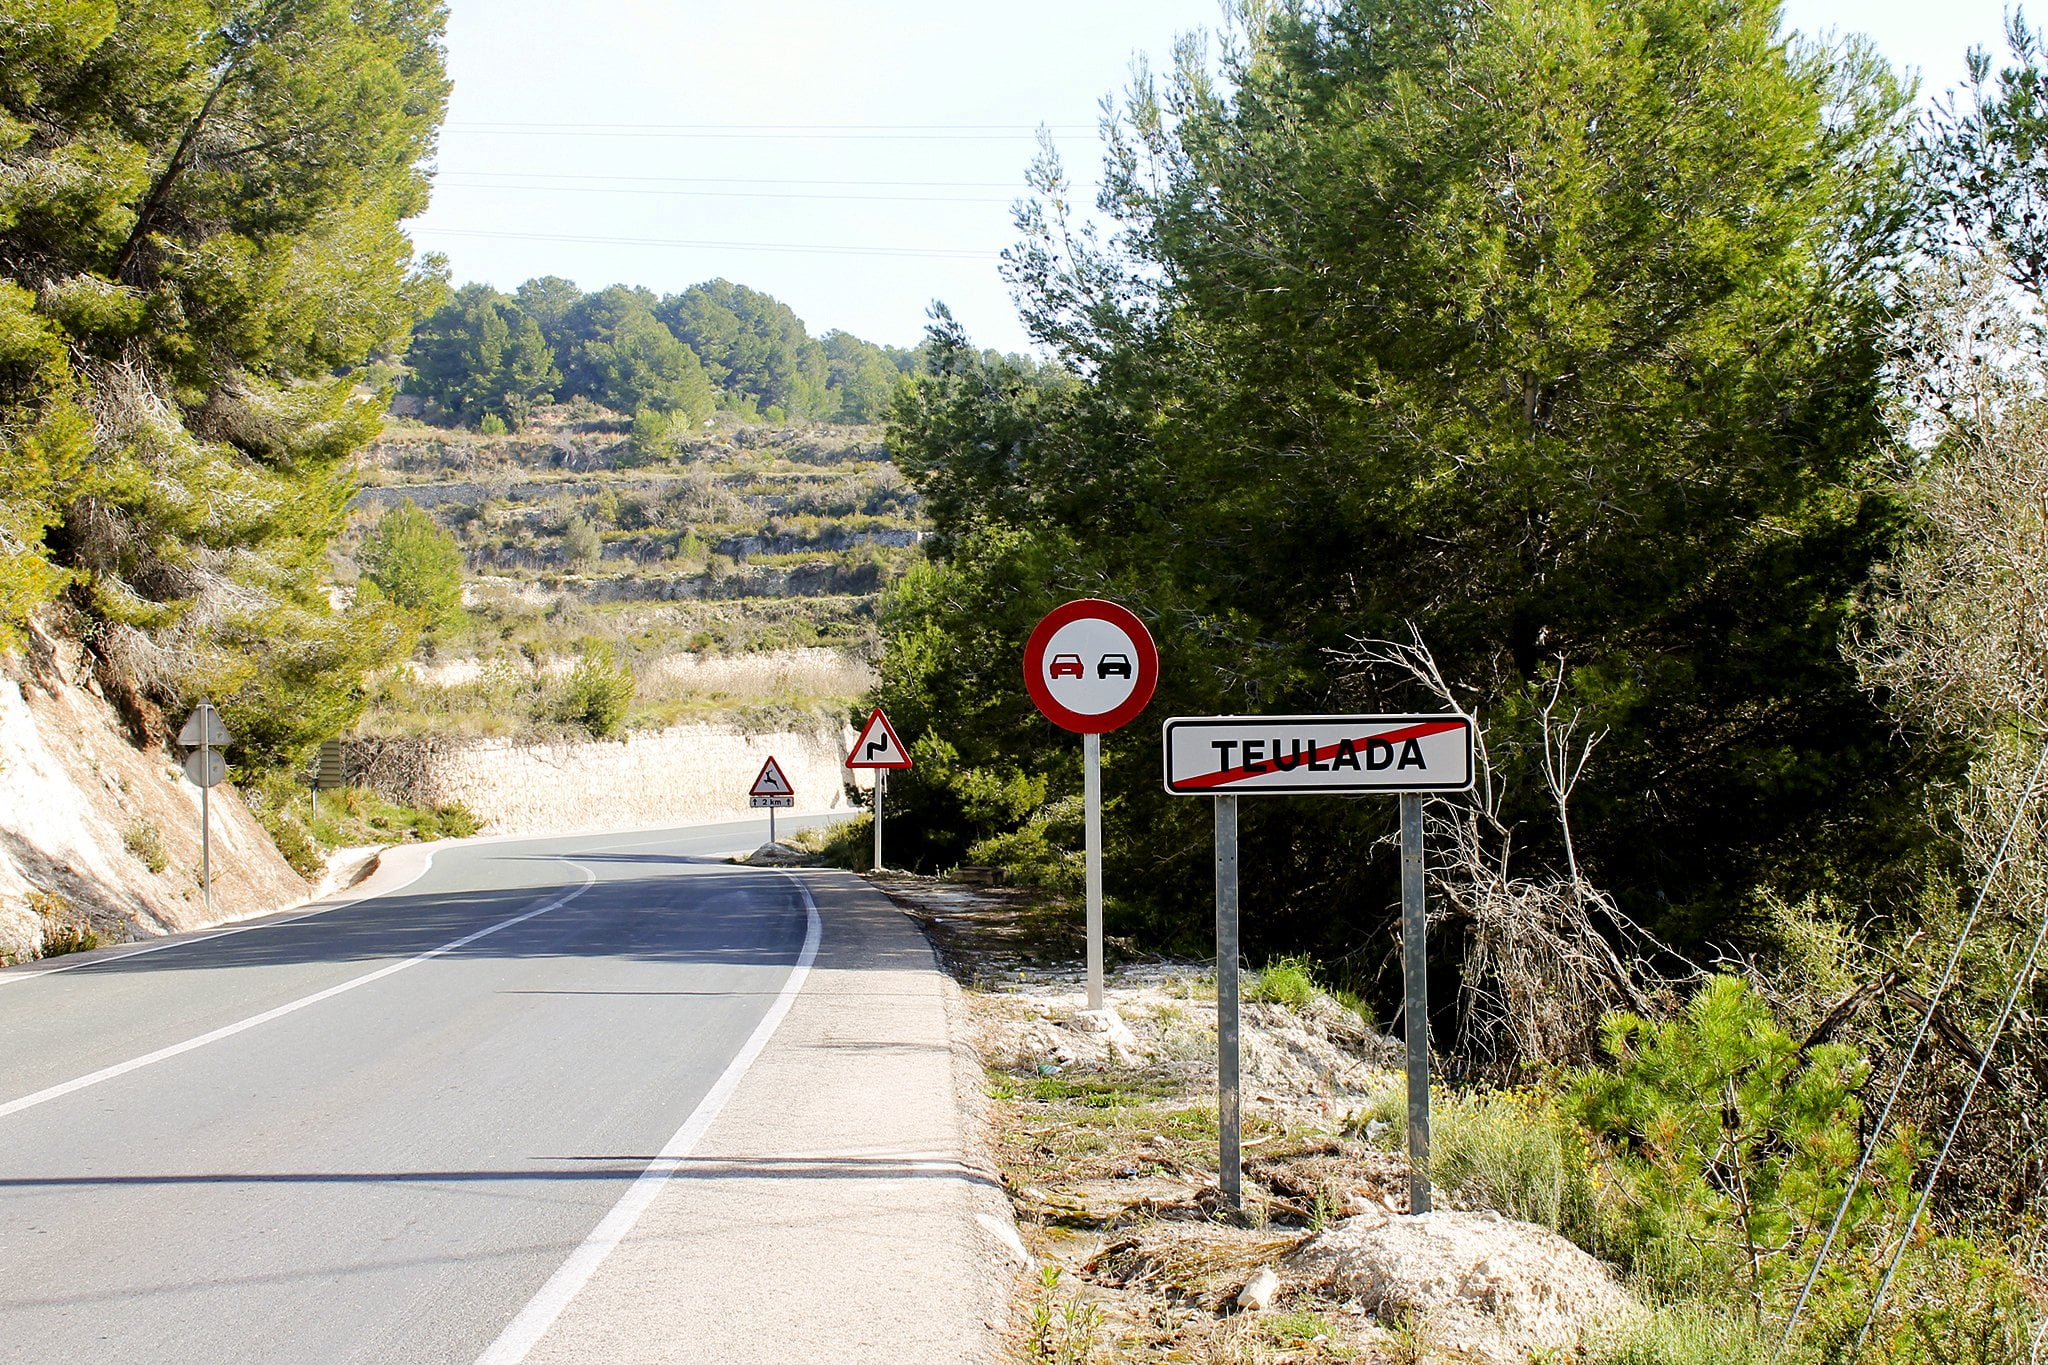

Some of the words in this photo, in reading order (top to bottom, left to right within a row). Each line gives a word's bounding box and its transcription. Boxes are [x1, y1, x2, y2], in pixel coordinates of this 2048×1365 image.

[1212, 738, 1427, 772] TEULADA
[762, 798, 768, 806] 2
[769, 798, 782, 806] km
